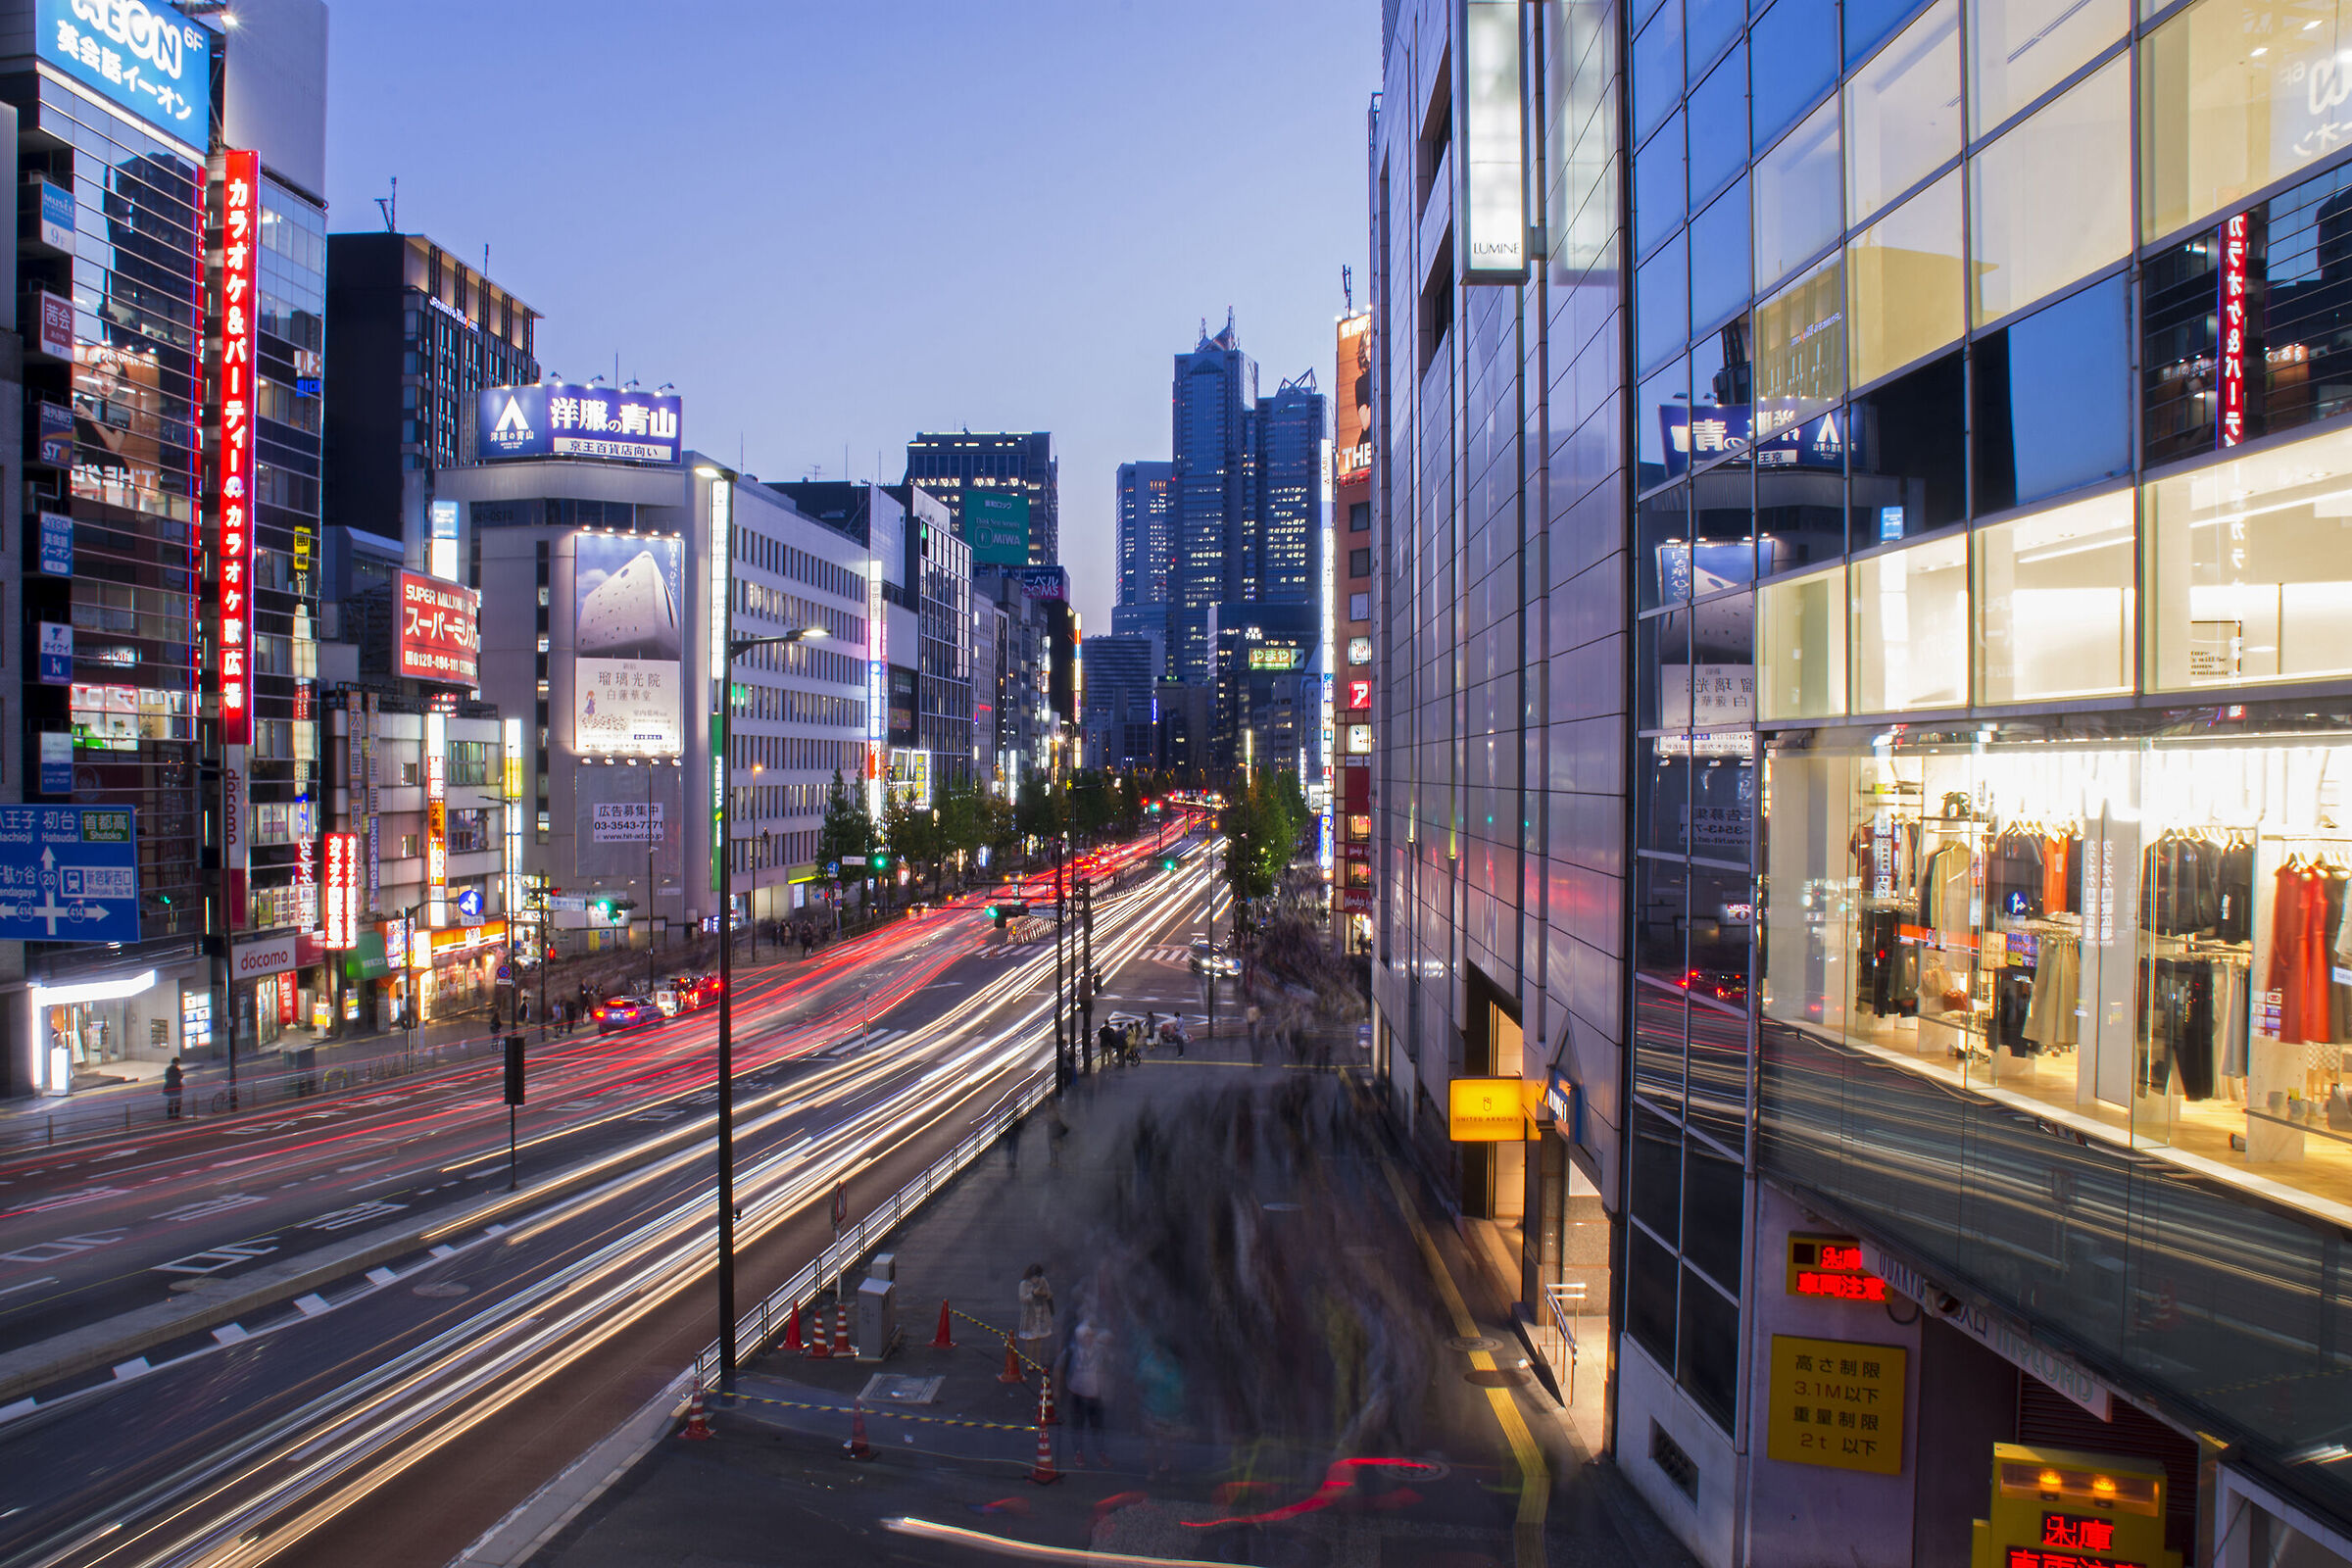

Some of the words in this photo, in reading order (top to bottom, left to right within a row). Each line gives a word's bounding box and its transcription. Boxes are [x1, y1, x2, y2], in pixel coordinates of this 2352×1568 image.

[183, 26, 204, 51] 6F
[57, 20, 192, 121] 英会話イーオン
[1473, 242, 1519, 255] LUMINE
[550, 397, 677, 438] 洋服の青山
[490, 429, 534, 442] 洋服の青山
[569, 440, 659, 457] 京王百貨店向い
[993, 533, 1021, 546] MIWA
[405, 583, 437, 605] SUPER
[222, 505, 245, 710] カラオケ歌広場
[1251, 649, 1290, 662] やまや
[599, 671, 661, 688] 瑠璃光院
[1353, 684, 1368, 706] ア
[226, 768, 239, 846] docomo
[599, 805, 660, 817] 広告募集中
[43, 810, 75, 830] 初台
[84, 813, 127, 830] 首都高
[41, 833, 78, 843] Hatsudai
[89, 830, 122, 841] Shutoko
[298, 836, 314, 885] カラオケ
[369, 817, 378, 890] EXCHANGE
[43, 872, 56, 886] 20
[19, 907, 32, 917] 414
[71, 907, 84, 918] 414
[241, 949, 289, 972] docomo
[1795, 1354, 1881, 1380] 高さ制限
[1794, 1380, 1880, 1404] 3.1M以下
[1793, 1405, 1879, 1431] 重量制限
[1841, 1439, 1878, 1456] 以下
